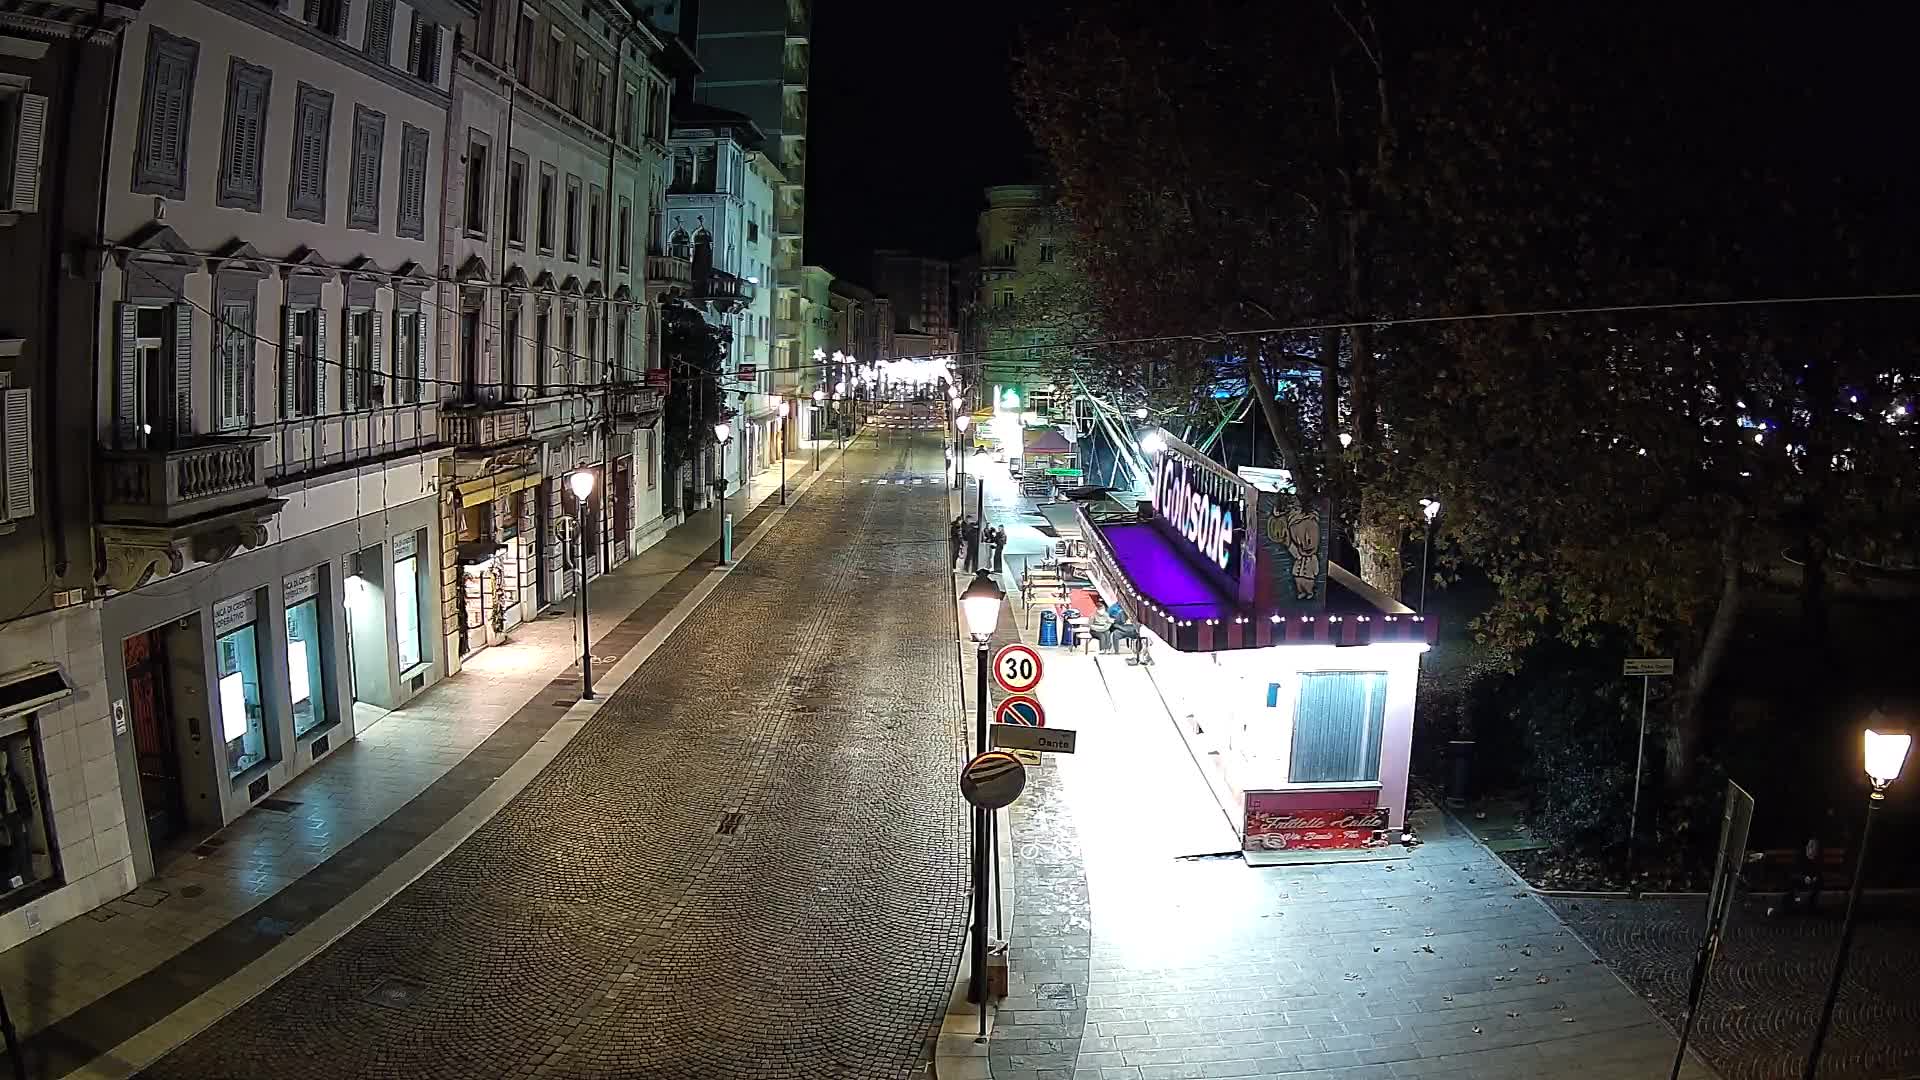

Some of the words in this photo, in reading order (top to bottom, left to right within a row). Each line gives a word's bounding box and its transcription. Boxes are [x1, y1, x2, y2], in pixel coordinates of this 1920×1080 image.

[1162, 458, 1233, 569] Golosone
[1005, 658, 1032, 679] 30
[1038, 737, 1069, 748] Dante
